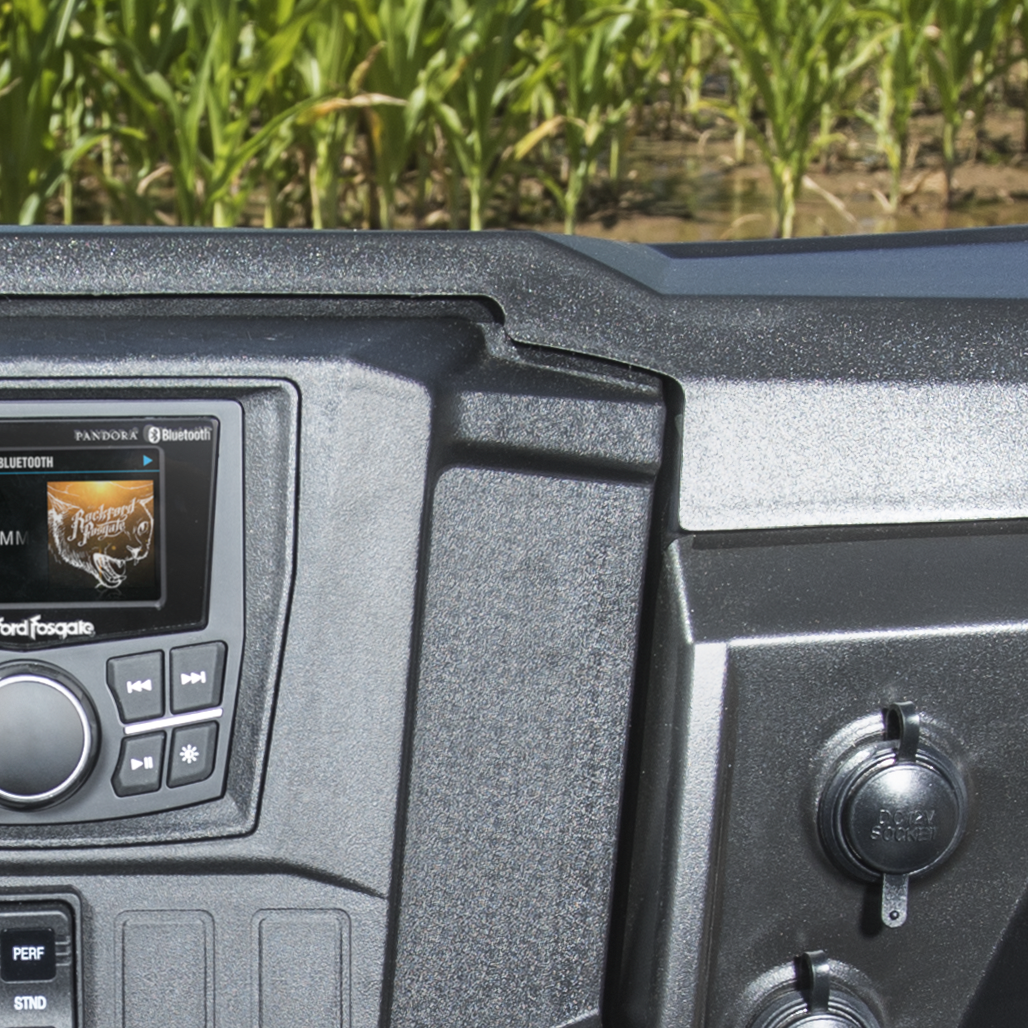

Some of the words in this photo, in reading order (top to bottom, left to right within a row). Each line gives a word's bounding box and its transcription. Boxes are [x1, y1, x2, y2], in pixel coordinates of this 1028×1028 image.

[75, 429, 139, 441] PANDORA
[161, 427, 211, 442] Bluetooth
[12, 945, 45, 961] PERF
[13, 995, 47, 1011] STND
